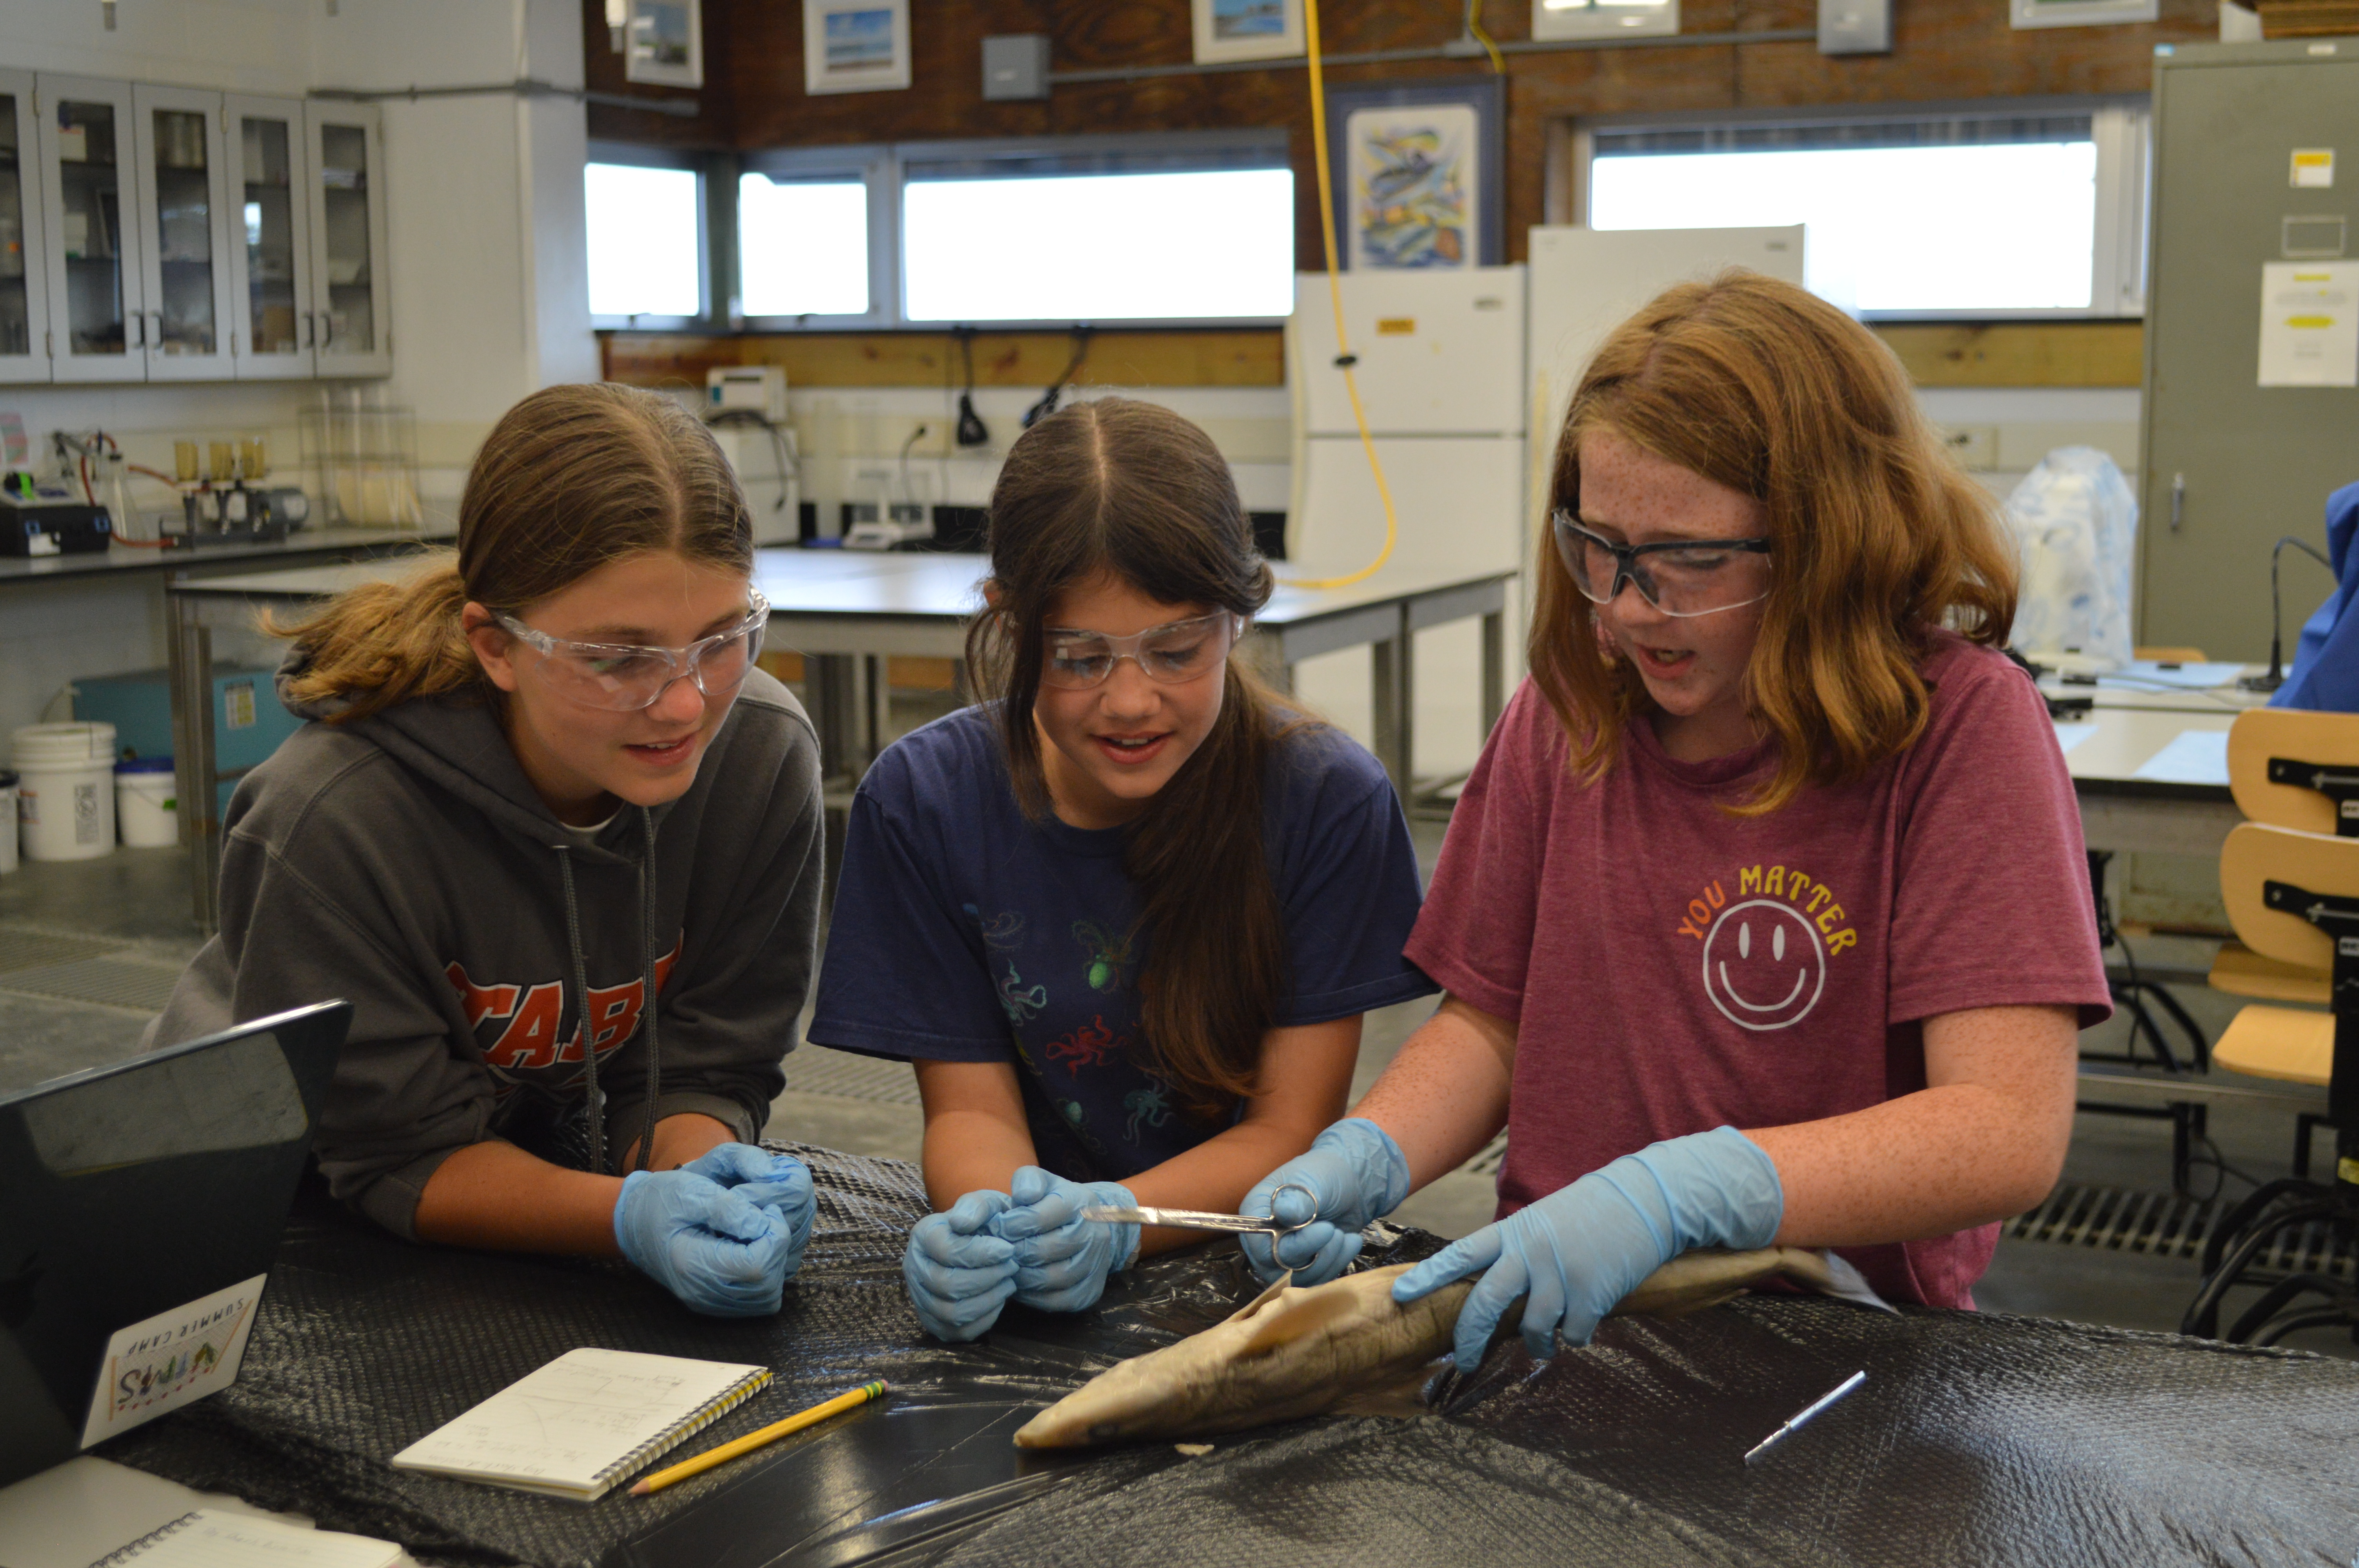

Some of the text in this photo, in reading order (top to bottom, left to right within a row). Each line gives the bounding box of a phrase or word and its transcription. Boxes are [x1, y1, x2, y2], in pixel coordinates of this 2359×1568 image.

[1677, 864, 1857, 956] YOU MATTER
[445, 928, 684, 1068] TAB
[128, 1297, 244, 1356] SUMMER CAMP
